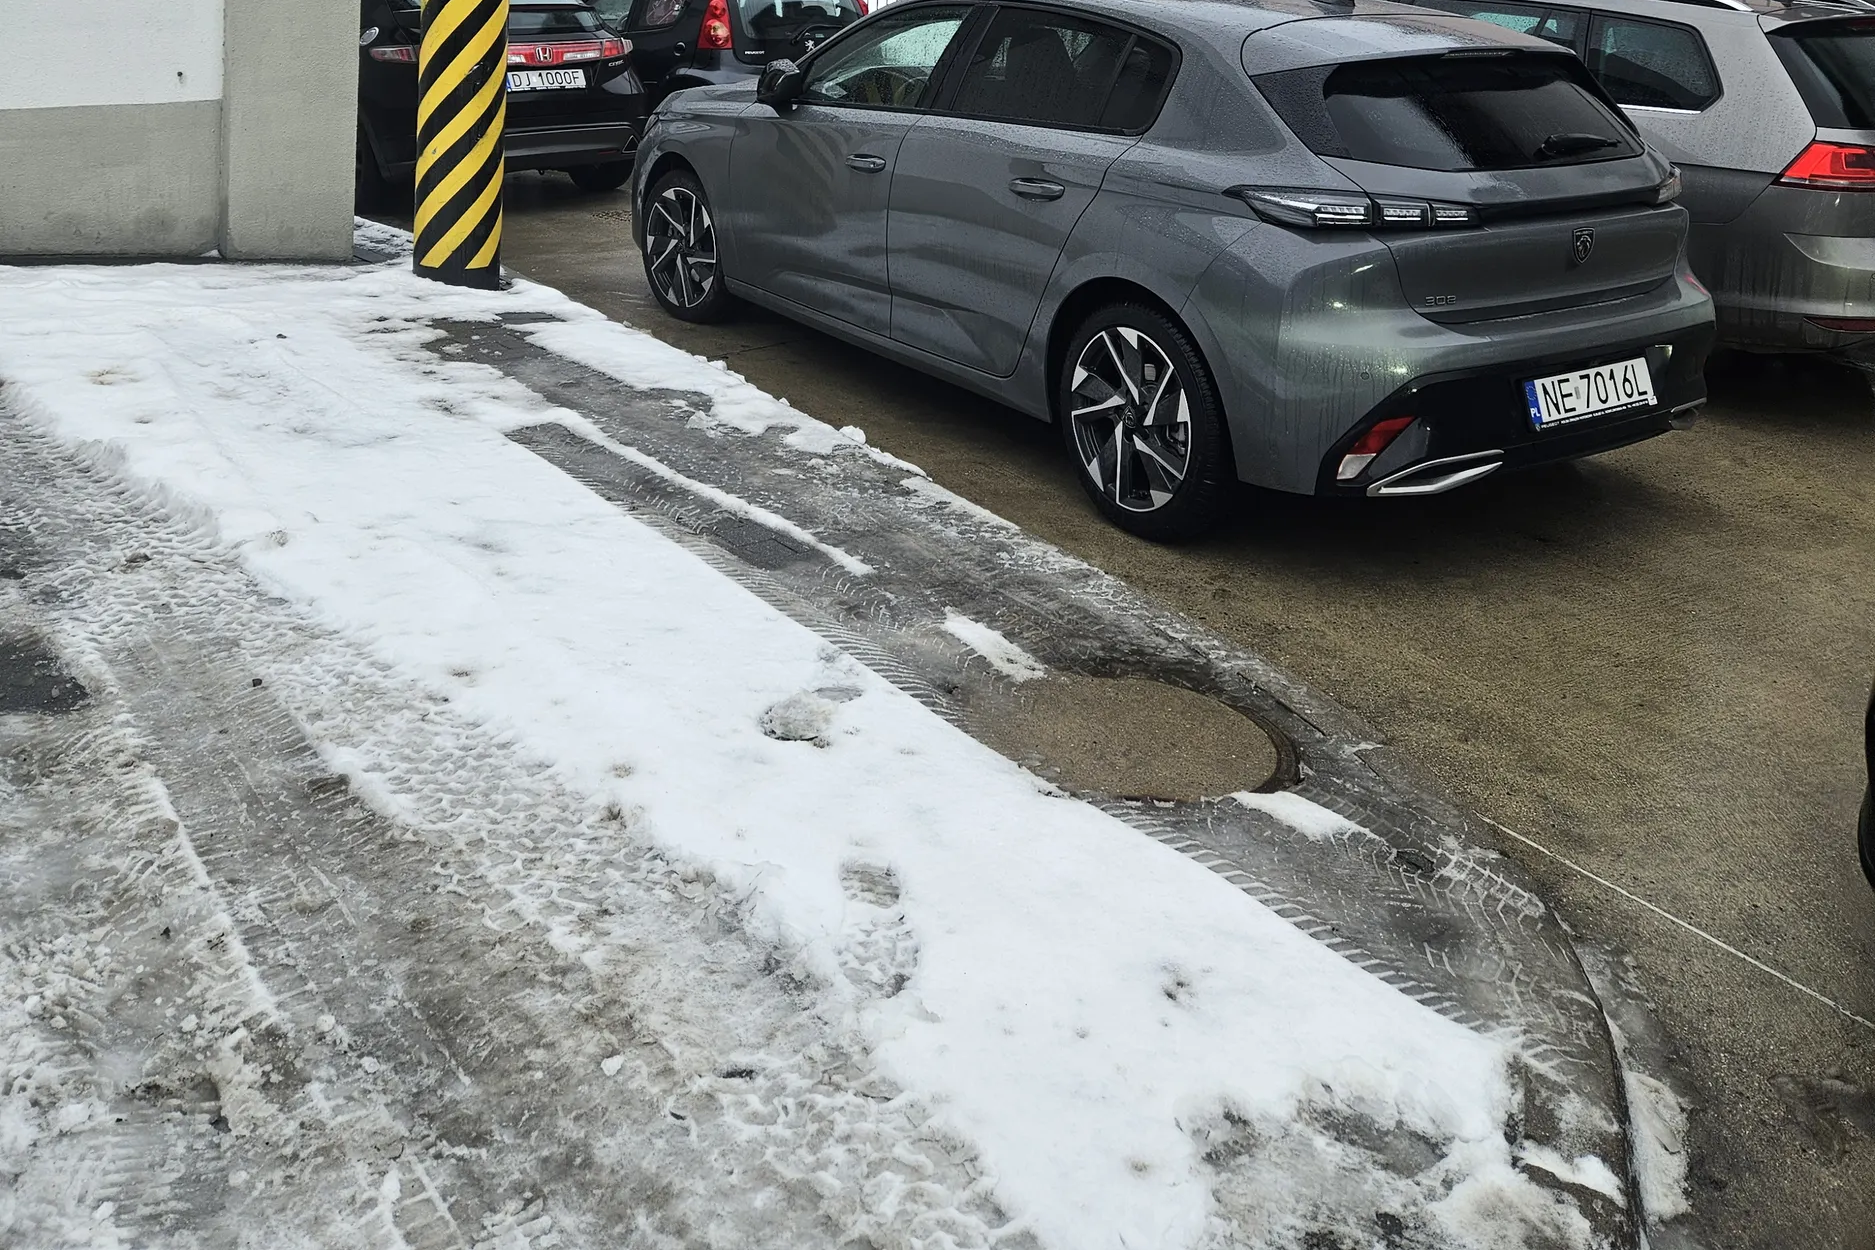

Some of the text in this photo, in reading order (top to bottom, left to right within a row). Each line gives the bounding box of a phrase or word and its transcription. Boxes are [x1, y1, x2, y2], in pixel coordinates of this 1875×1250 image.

[511, 70, 580, 87] DJ 1000F
[1541, 377, 1576, 418] NE
[1579, 364, 1648, 409] 7016L
[1530, 407, 1541, 418] PL
